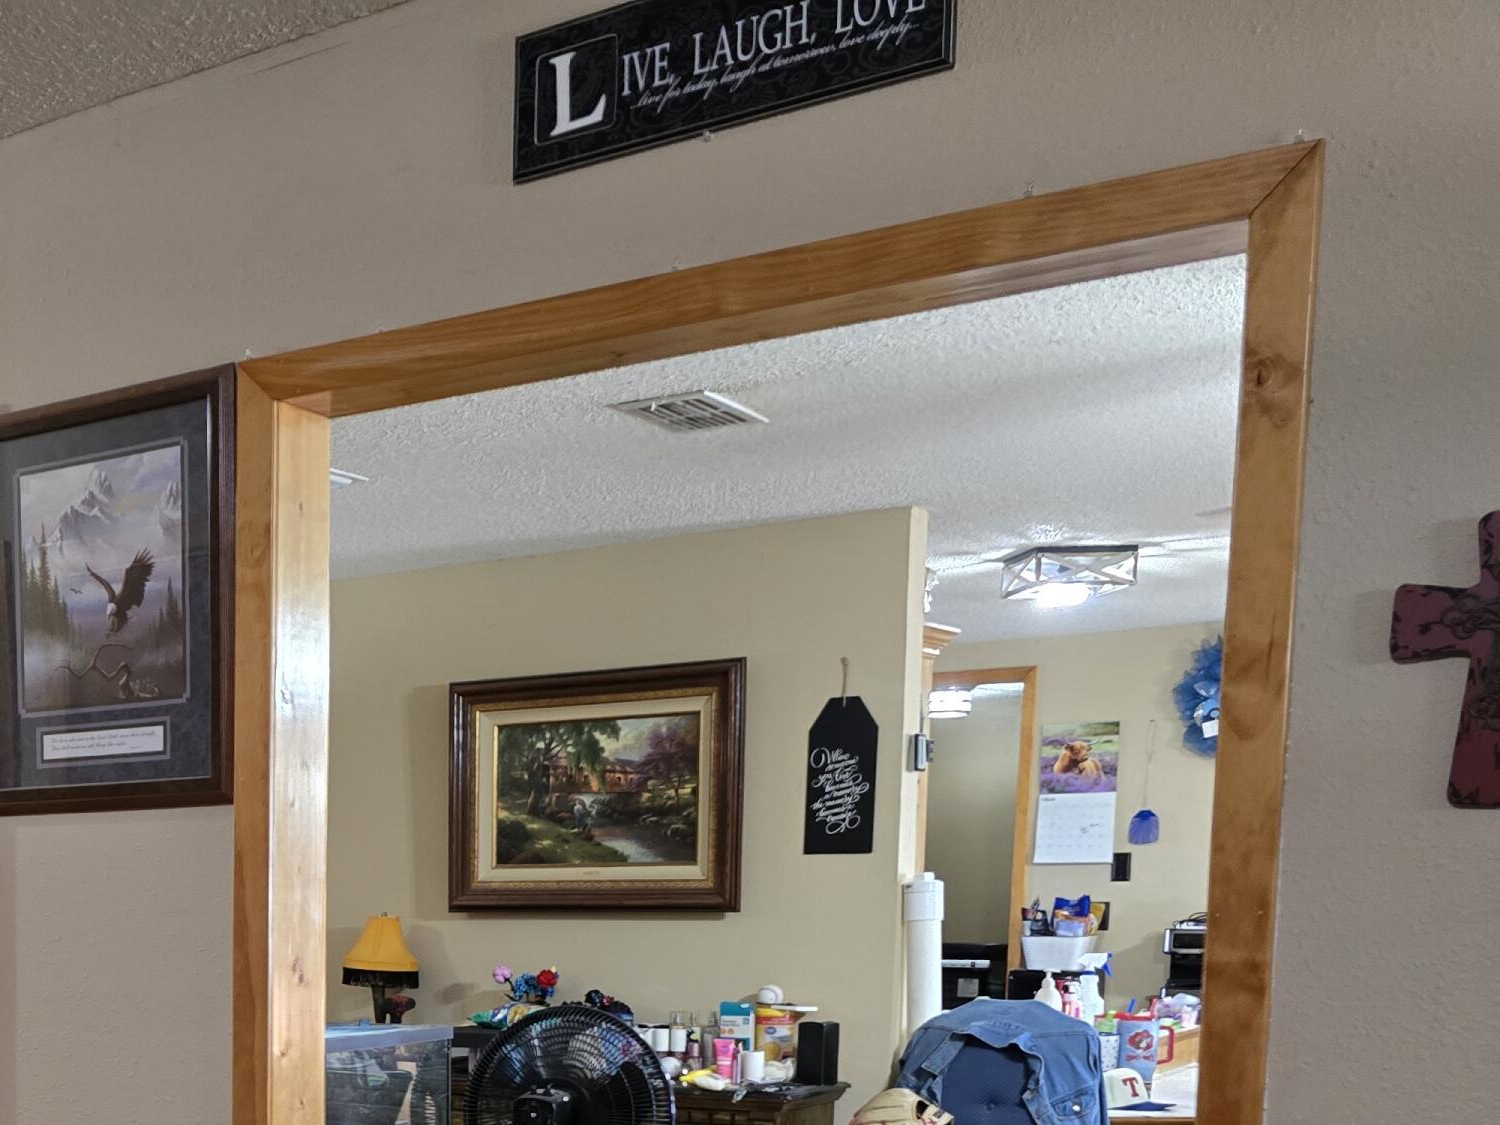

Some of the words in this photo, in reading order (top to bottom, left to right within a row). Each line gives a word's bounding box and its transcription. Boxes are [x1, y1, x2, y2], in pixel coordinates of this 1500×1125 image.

[693, 0, 817, 75] LAUGH,
[835, 0, 926, 34] LO
[656, 76, 681, 114] for
[720, 52, 765, 93] laugh
[1122, 1077, 1139, 1098] T
